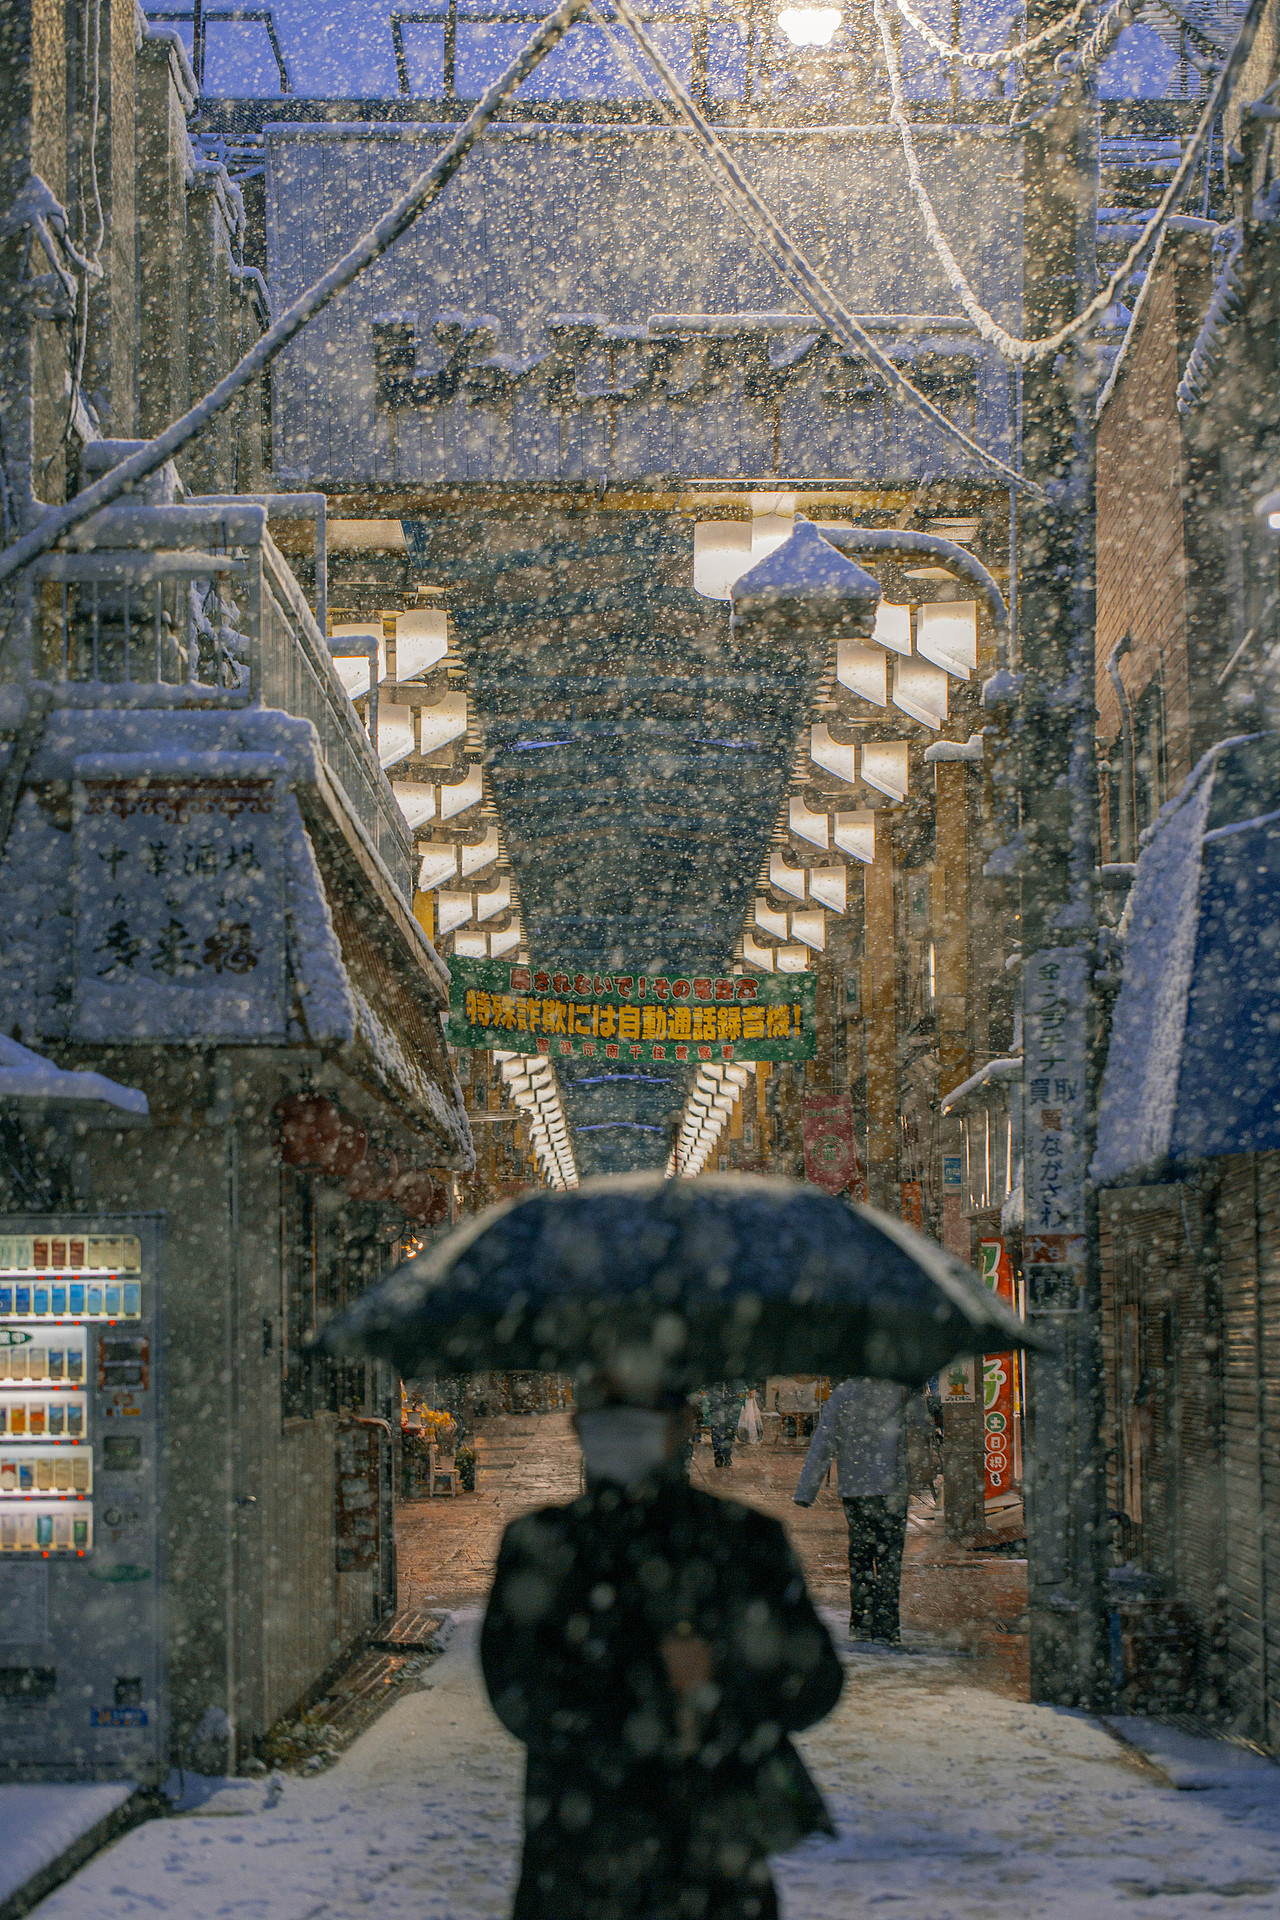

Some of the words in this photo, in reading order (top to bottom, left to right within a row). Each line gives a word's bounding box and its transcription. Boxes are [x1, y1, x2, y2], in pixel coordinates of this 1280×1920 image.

[535, 1036, 735, 1061] 警視庁南千住警察署
